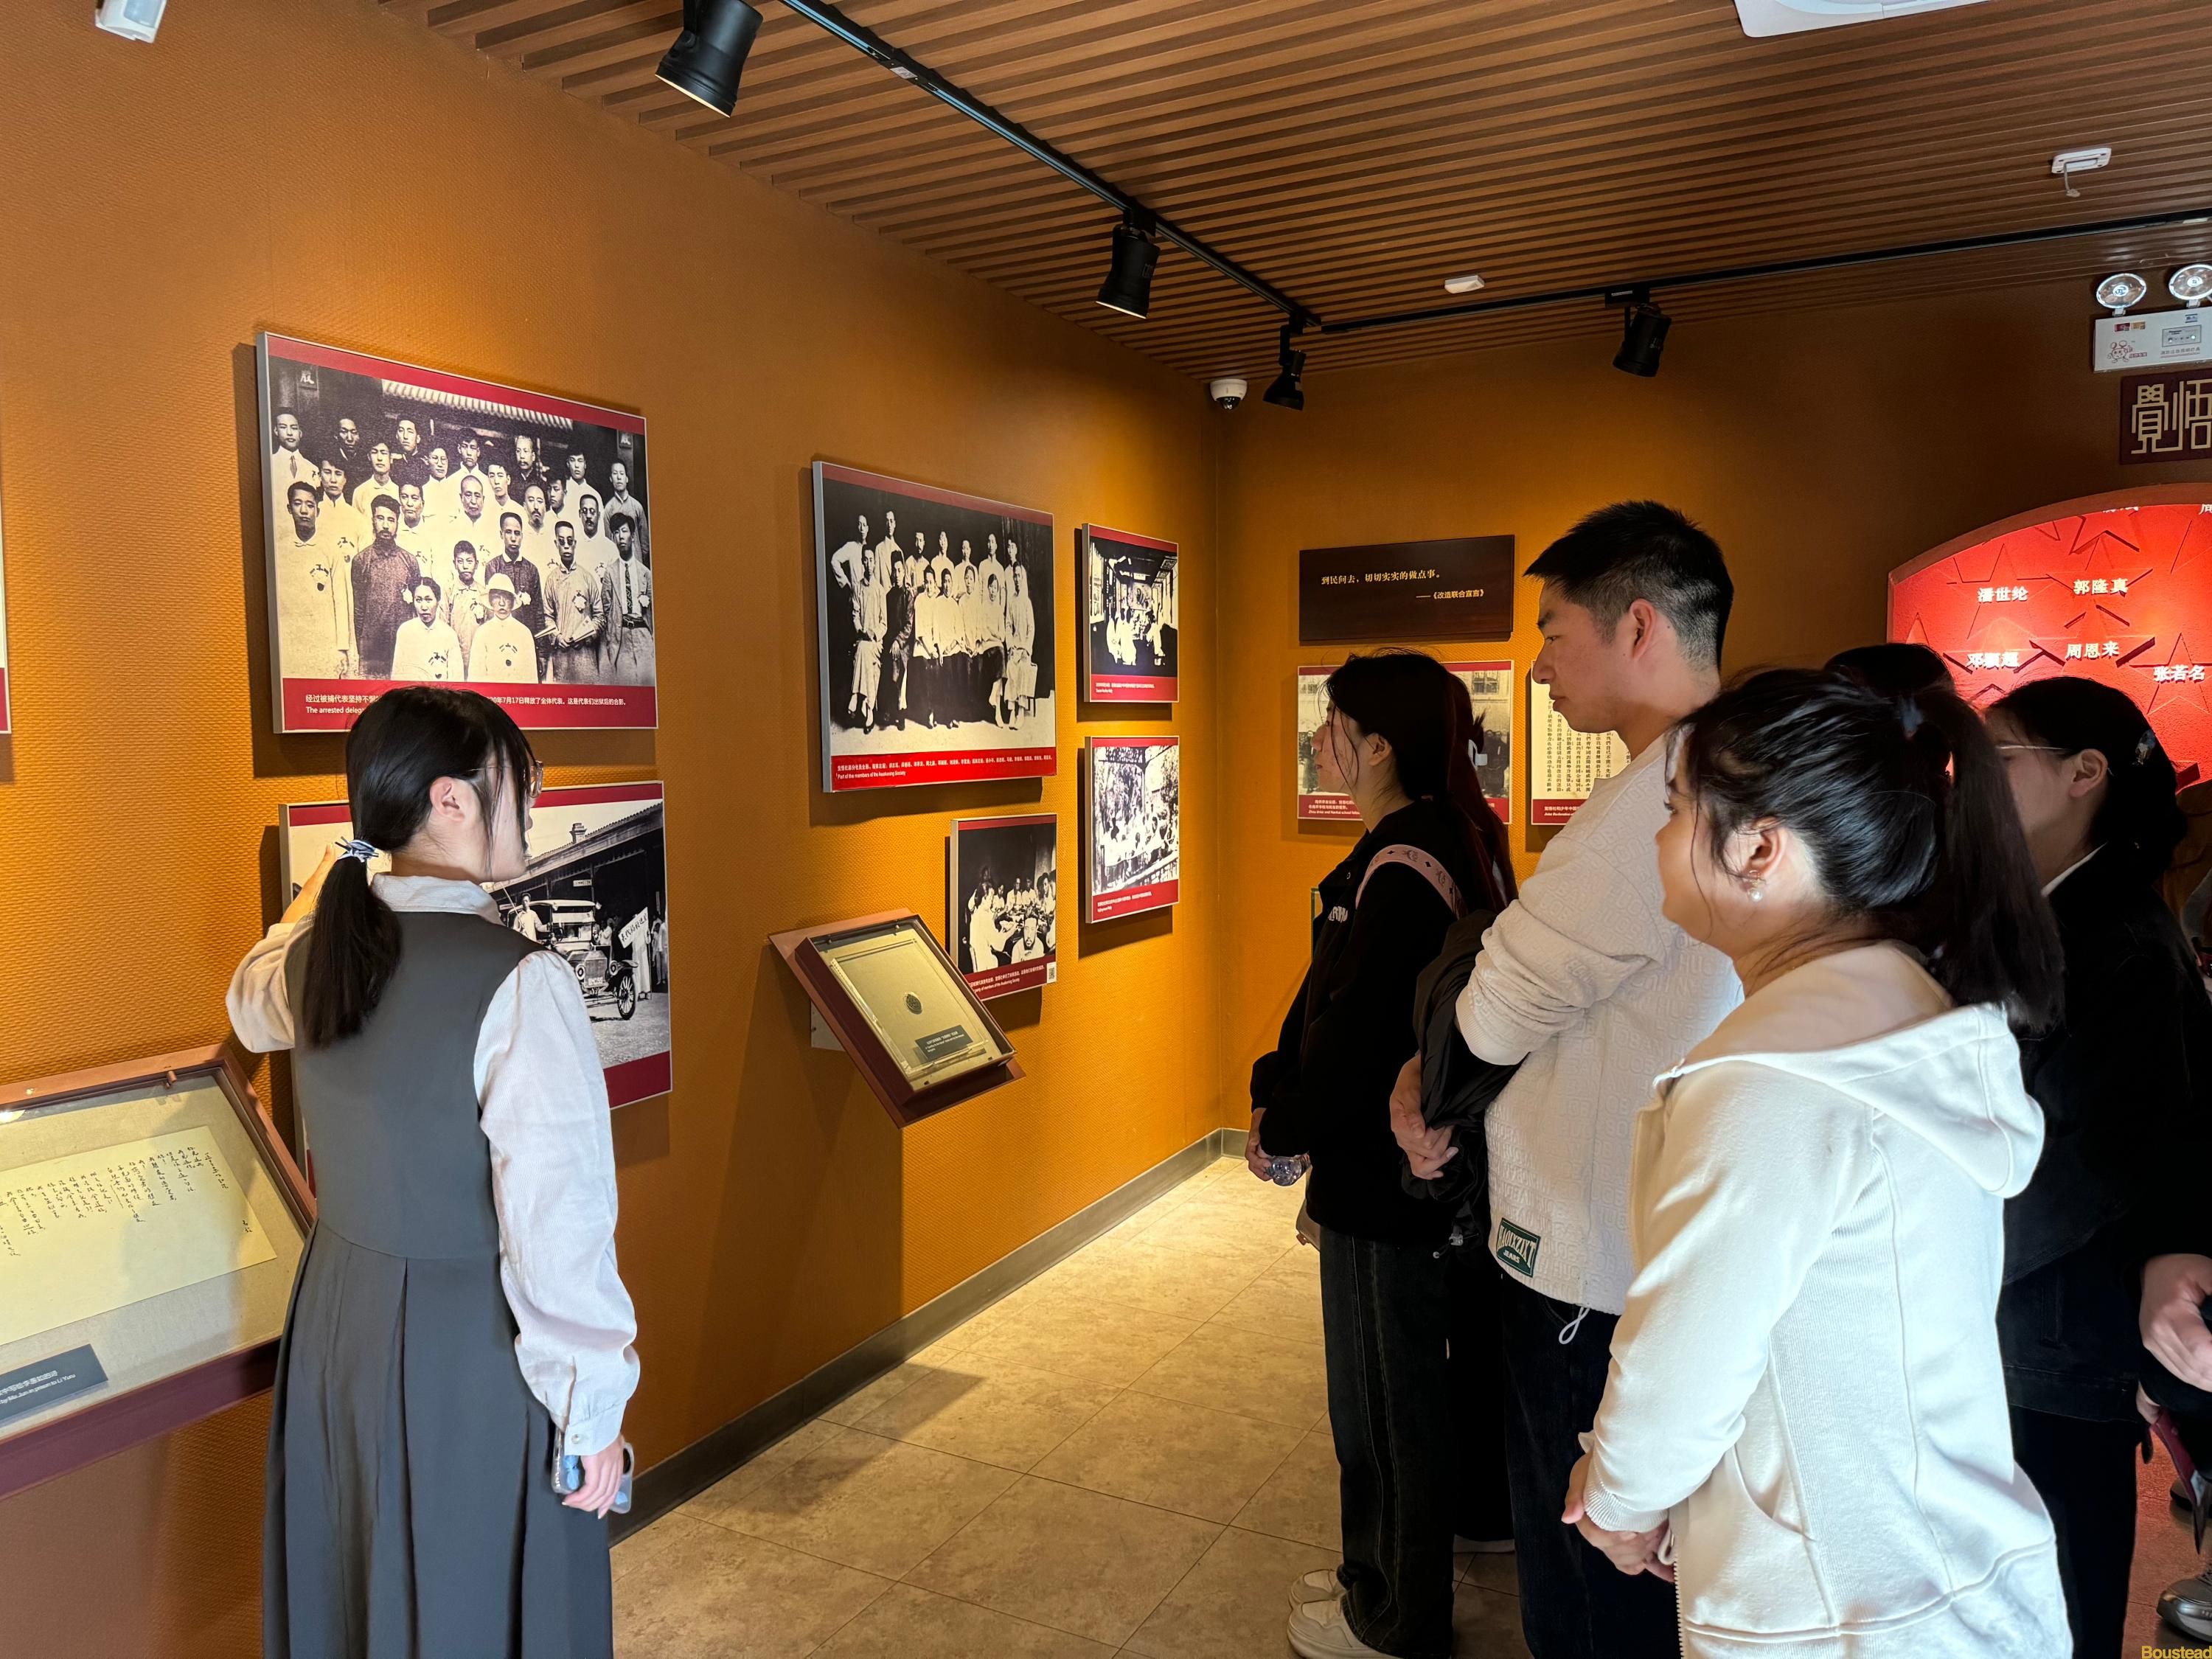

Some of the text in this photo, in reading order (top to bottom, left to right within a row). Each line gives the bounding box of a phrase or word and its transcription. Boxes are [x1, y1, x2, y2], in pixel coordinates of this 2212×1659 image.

[1978, 586, 2028, 602] 潘世纶
[2073, 578, 2129, 596] 郭隆真
[2065, 641, 2120, 660] 周恩来
[2153, 665, 2206, 683] 张若名
